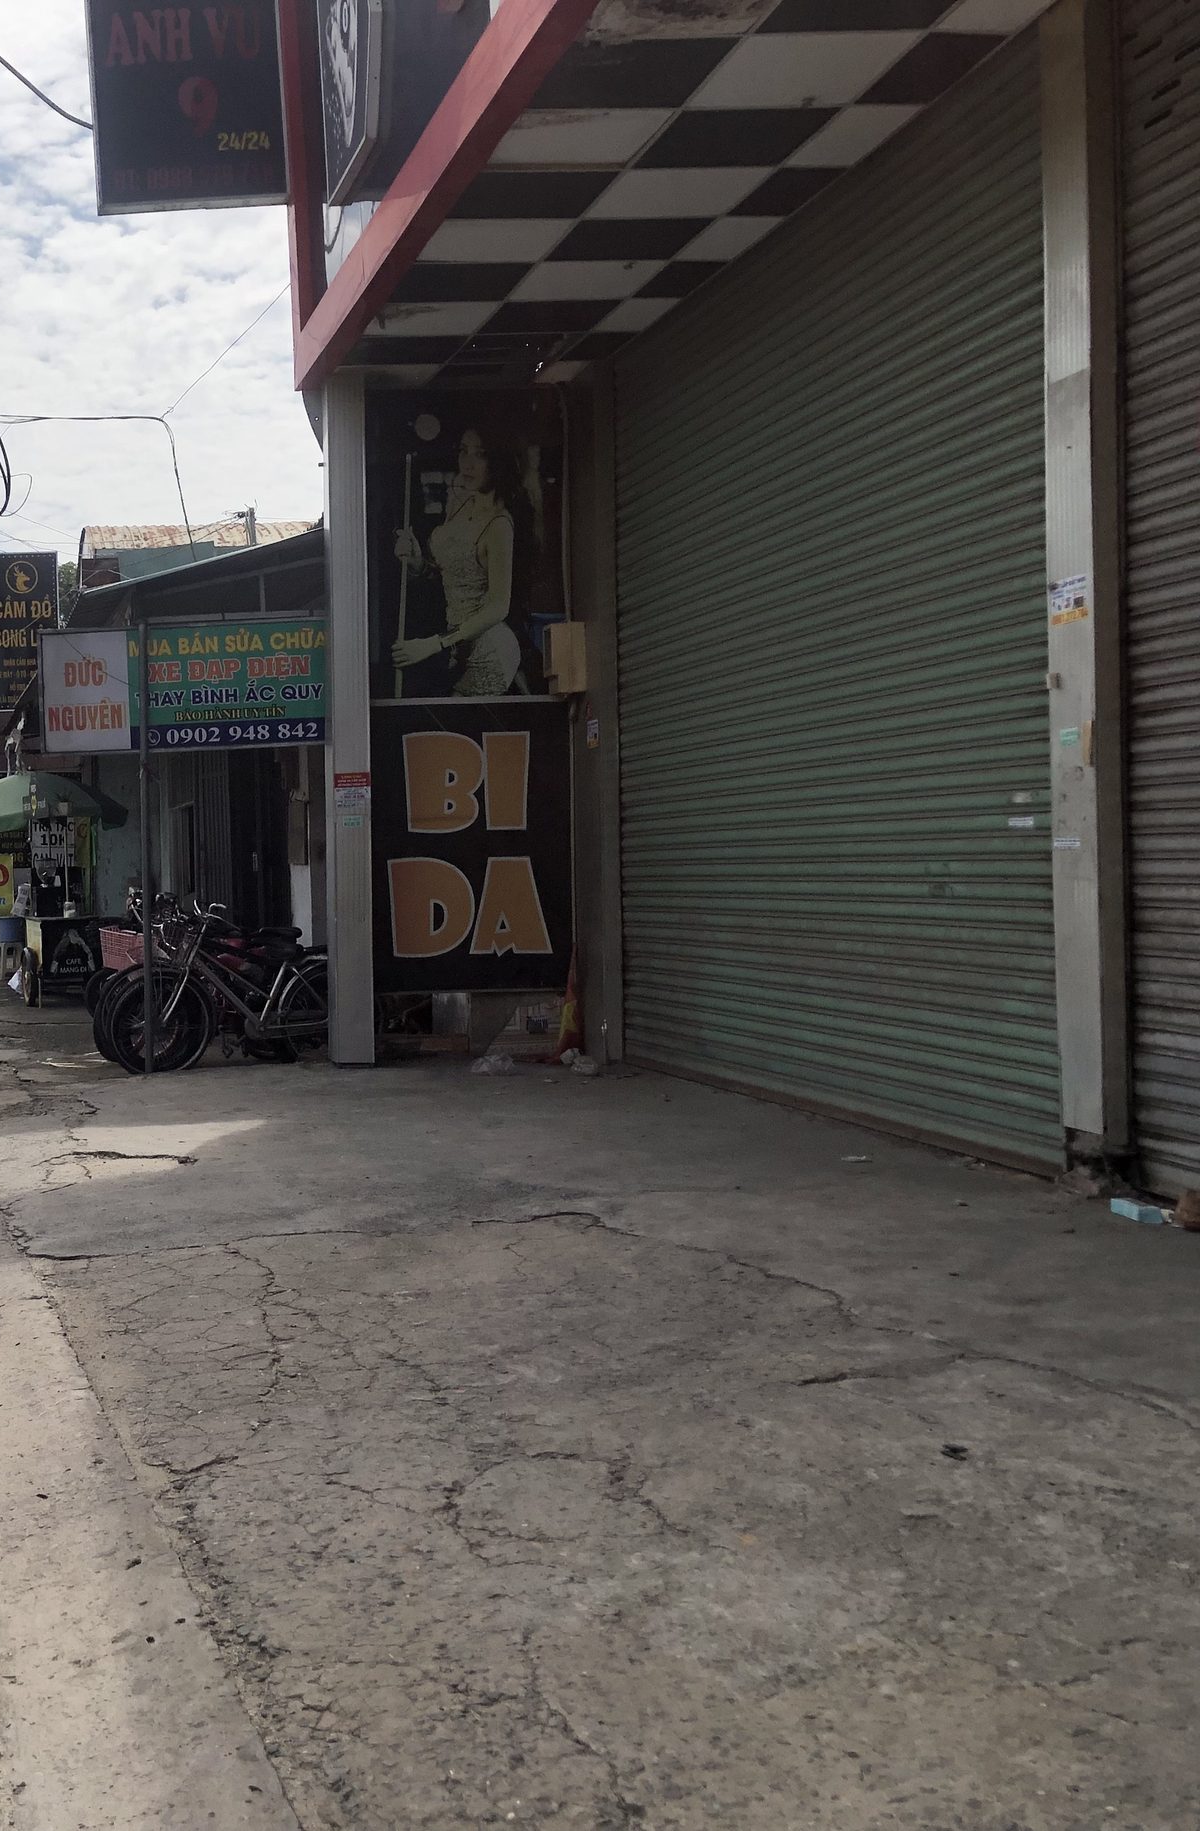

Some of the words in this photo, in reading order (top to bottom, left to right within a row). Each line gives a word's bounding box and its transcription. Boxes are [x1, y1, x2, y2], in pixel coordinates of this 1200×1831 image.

[106, 8, 193, 67] ANH
[177, 76, 219, 137] 9
[217, 132, 271, 151] 24/24
[31, 594, 51, 618] ĐỒ
[178, 633, 219, 655] BÁN
[225, 628, 262, 653] SỬA
[270, 628, 327, 650] CHỮA
[64, 653, 107, 688] ĐỨC
[148, 661, 182, 683] XE
[188, 659, 240, 685] ĐẠP
[247, 652, 311, 680] ĐIỆN
[191, 685, 238, 706] BÌNH
[246, 680, 275, 702] ẮC
[280, 683, 324, 701] QUY
[48, 697, 123, 733] NGUYÊN
[204, 707, 241, 721] HÀNH
[244, 707, 260, 720] UY
[262, 704, 287, 718] TÍN
[166, 727, 221, 745] 0902
[228, 726, 270, 742] 948
[277, 723, 319, 739] 842
[402, 731, 530, 833] BI
[387, 856, 553, 958] DA
